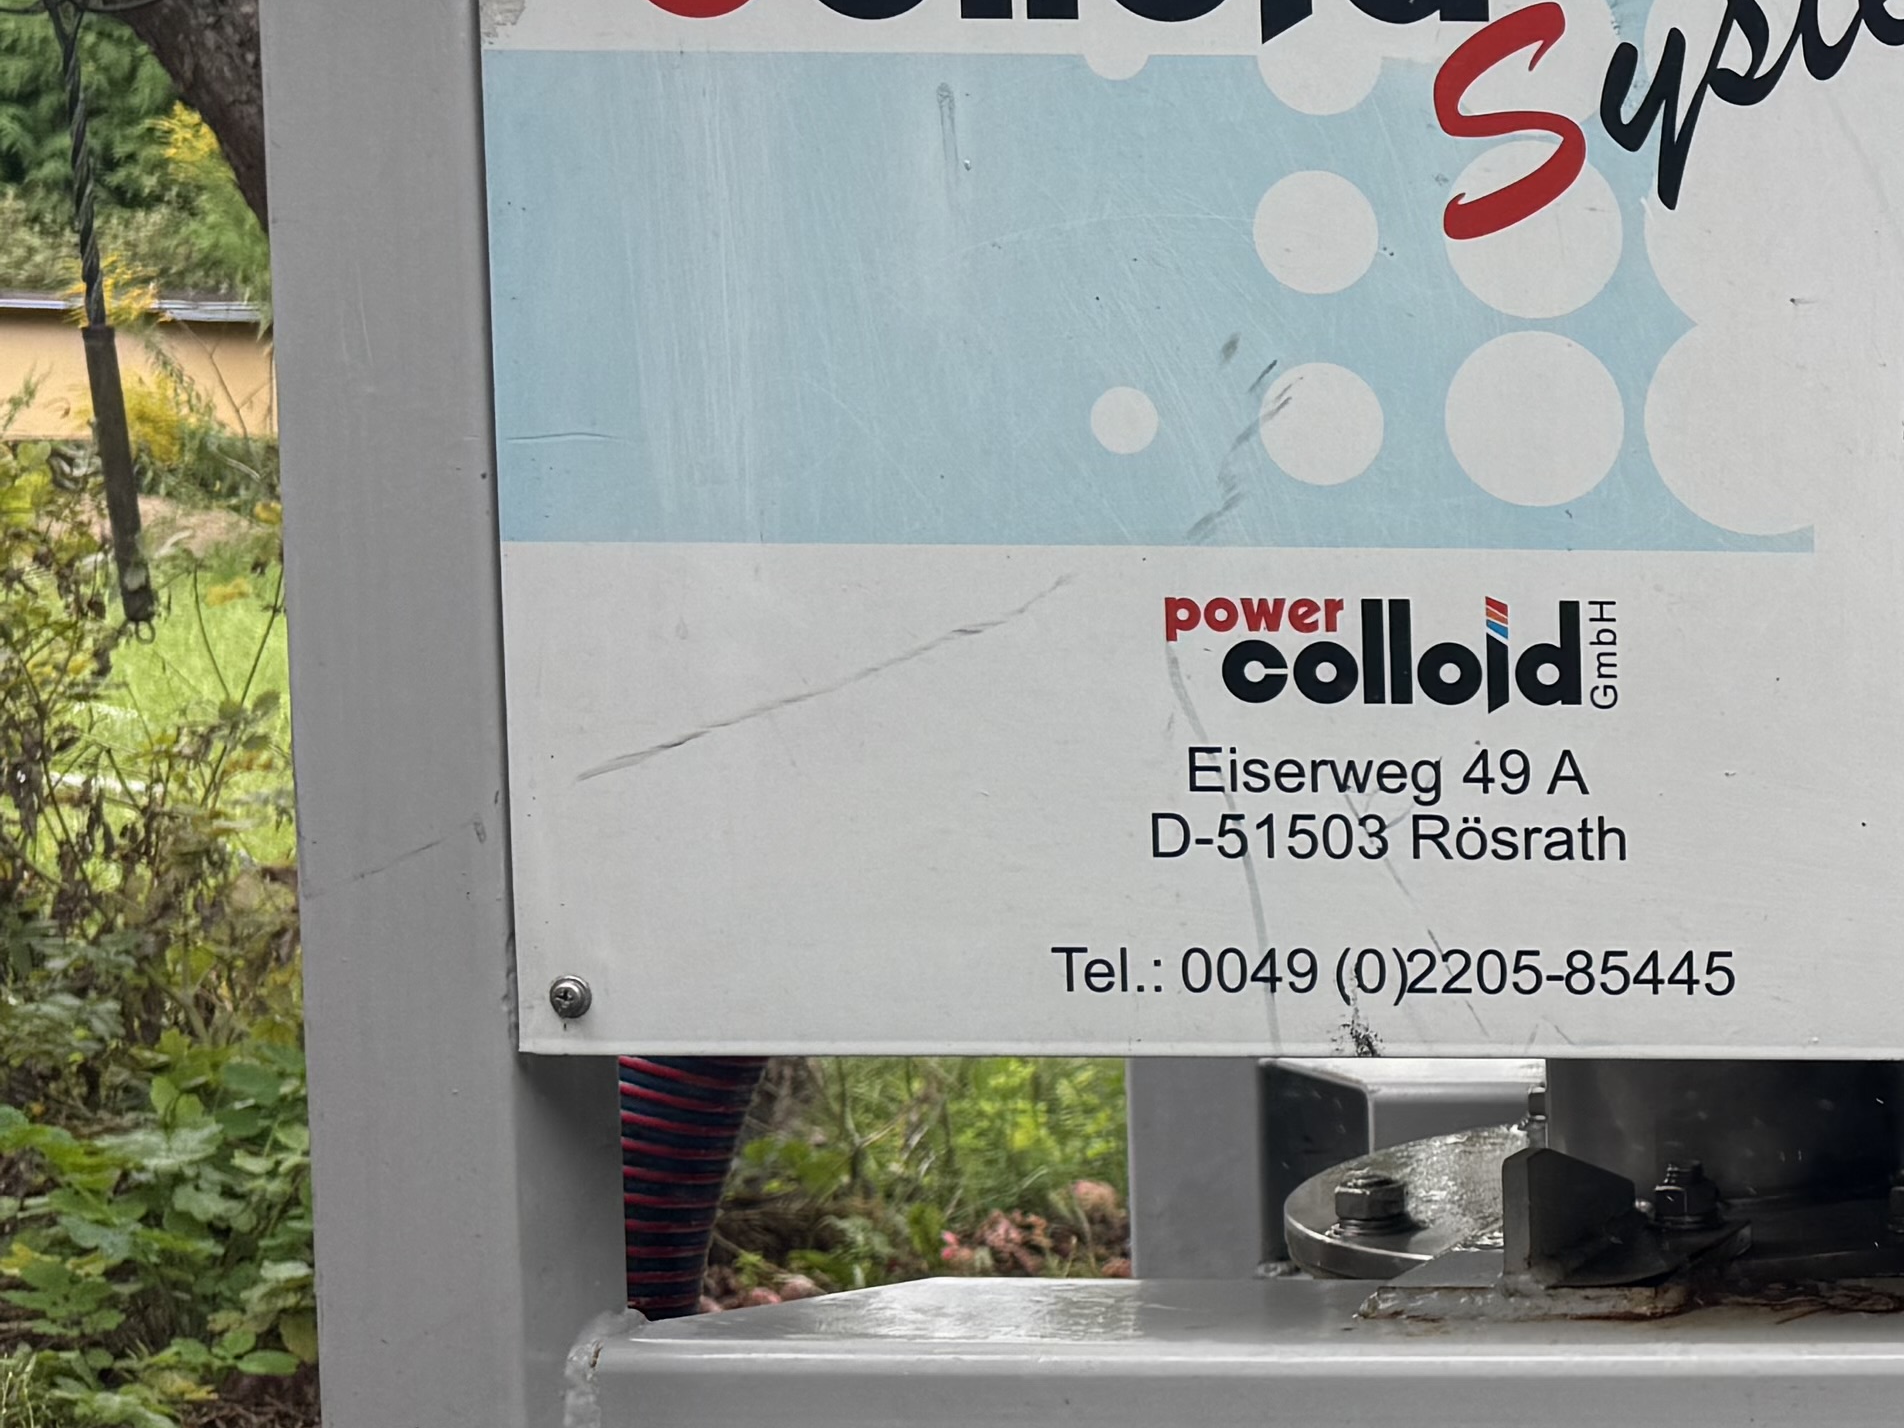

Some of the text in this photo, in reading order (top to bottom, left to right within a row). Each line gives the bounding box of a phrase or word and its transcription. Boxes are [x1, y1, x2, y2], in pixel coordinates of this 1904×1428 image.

[1164, 595, 1345, 642] power
[1221, 595, 1584, 714] colloid
[1589, 598, 1619, 710] GmbH
[1188, 746, 1590, 806] Eiserweg 49 A
[1151, 812, 1627, 862] D-51503 Rösrath
[1051, 946, 1736, 1006] Tel.: 0049 (0)2205-85445
